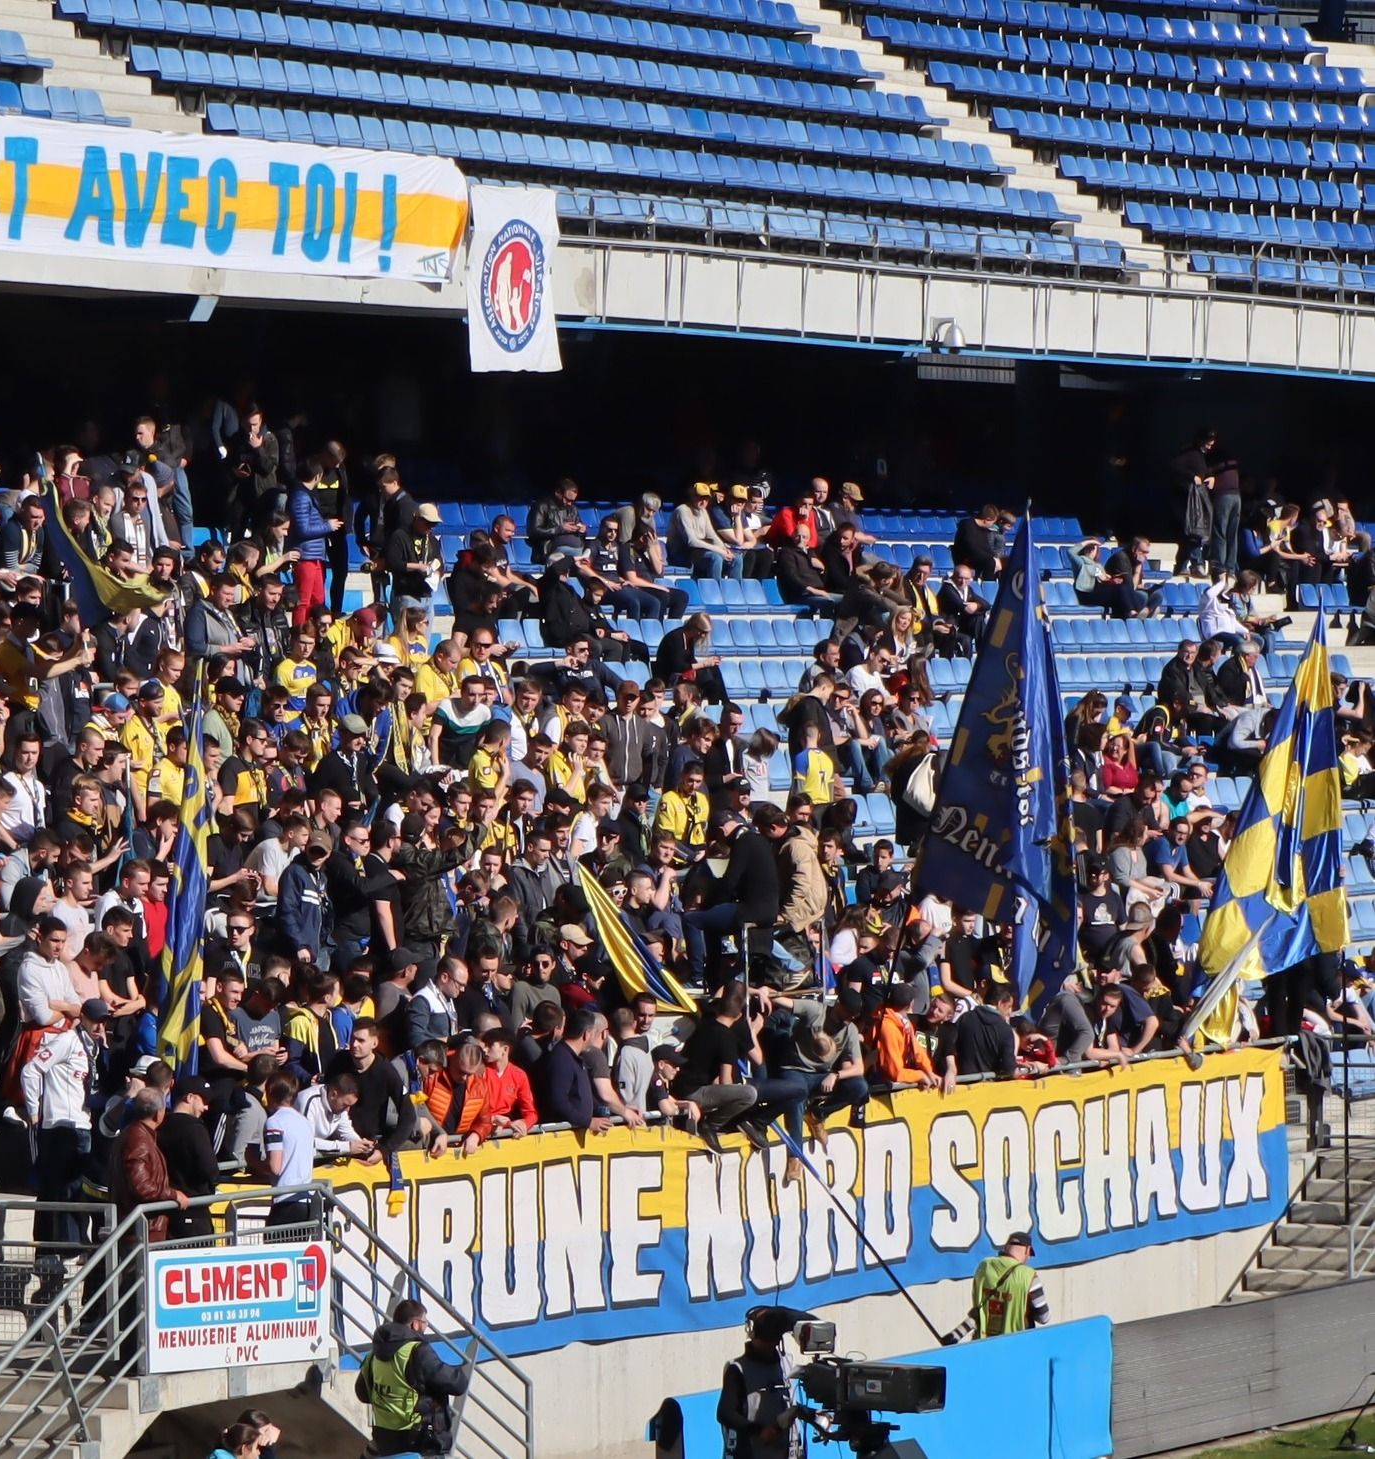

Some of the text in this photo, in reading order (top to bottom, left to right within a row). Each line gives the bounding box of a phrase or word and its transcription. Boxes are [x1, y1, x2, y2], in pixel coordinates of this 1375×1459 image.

[63, 146, 238, 256] AVEC
[268, 162, 358, 262] TOI
[226, 1071, 1269, 1352] RIBUNE NORD SOCHAUX
[158, 1320, 318, 1349] MENUISERIE ALUMINIUM
[224, 1345, 259, 1364] & PVC
